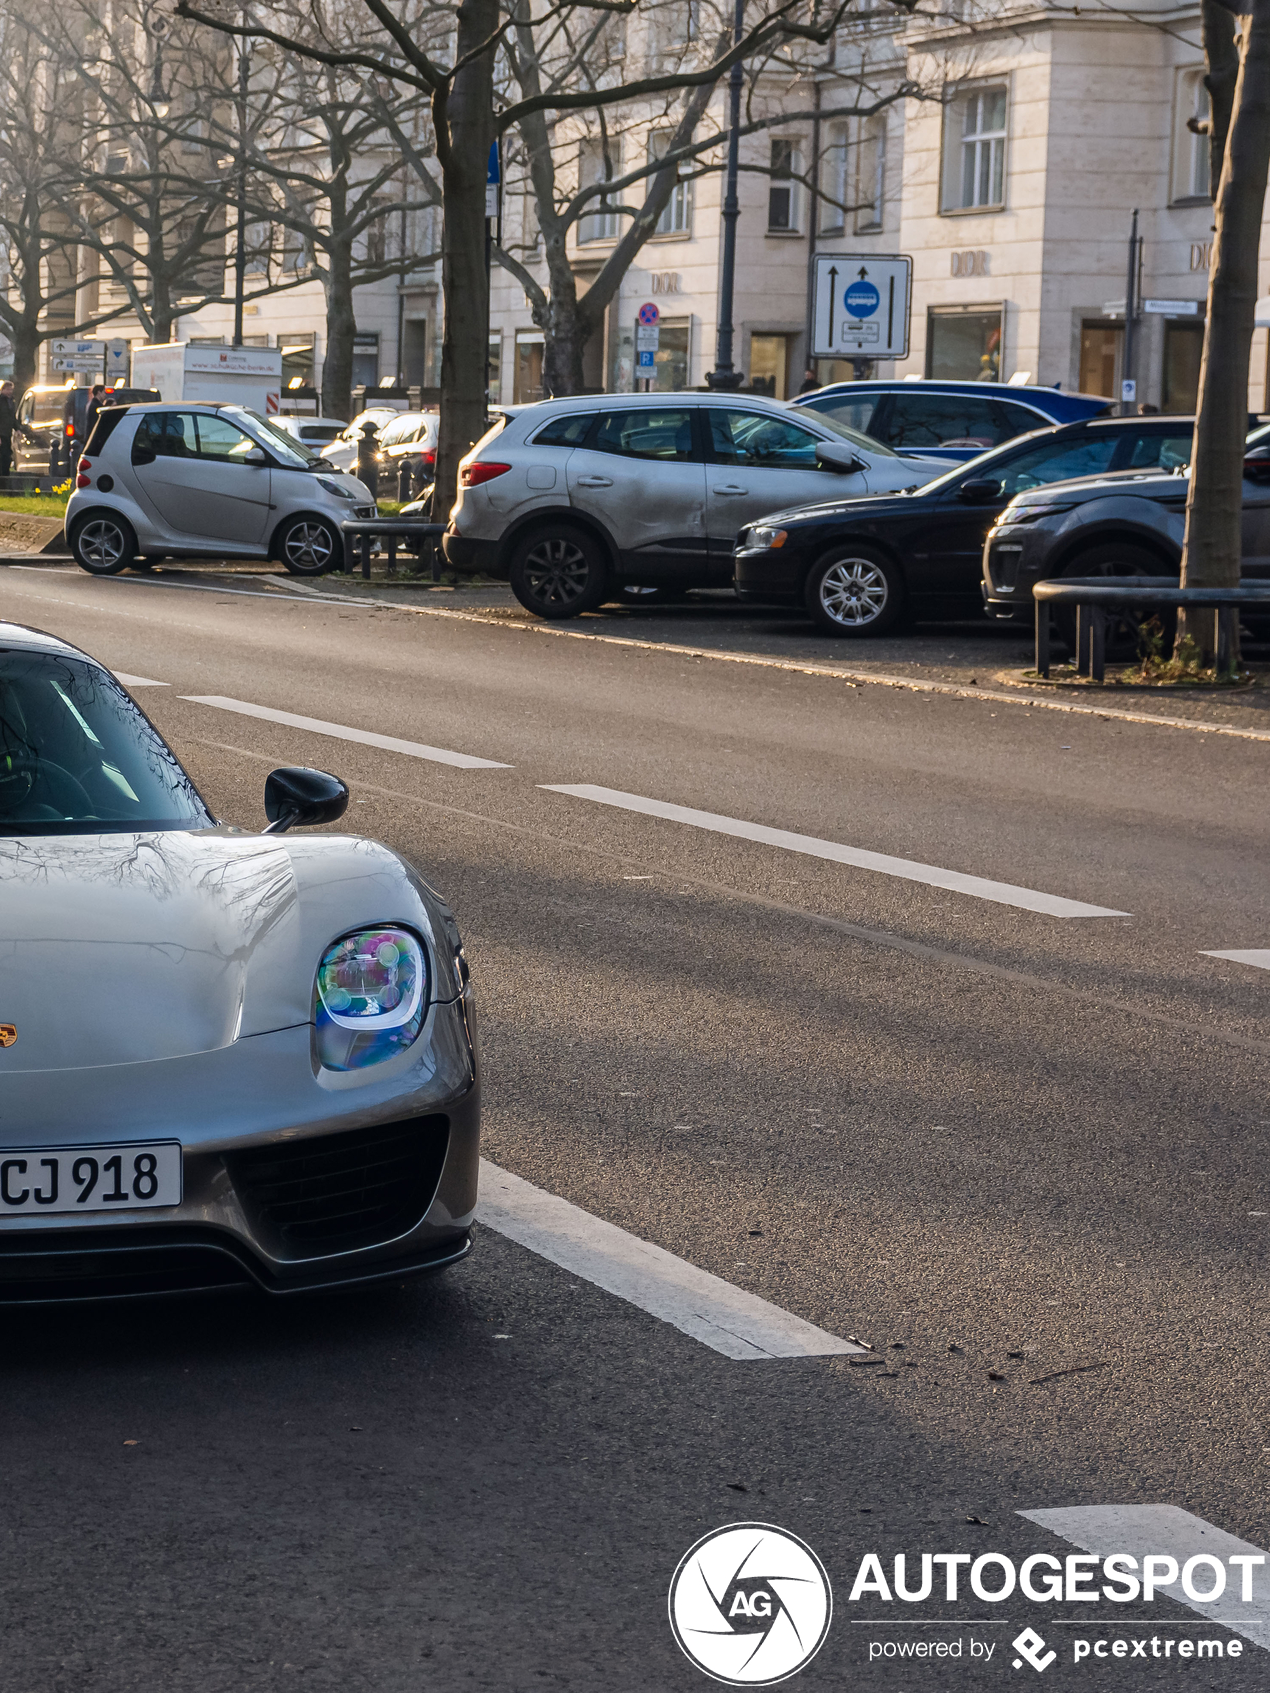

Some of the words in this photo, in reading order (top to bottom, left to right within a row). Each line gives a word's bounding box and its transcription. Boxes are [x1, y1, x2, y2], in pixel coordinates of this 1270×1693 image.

[950, 250, 987, 277] DIOR
[651, 272, 679, 295] DIOR
[72, 1153, 159, 1204] 918
